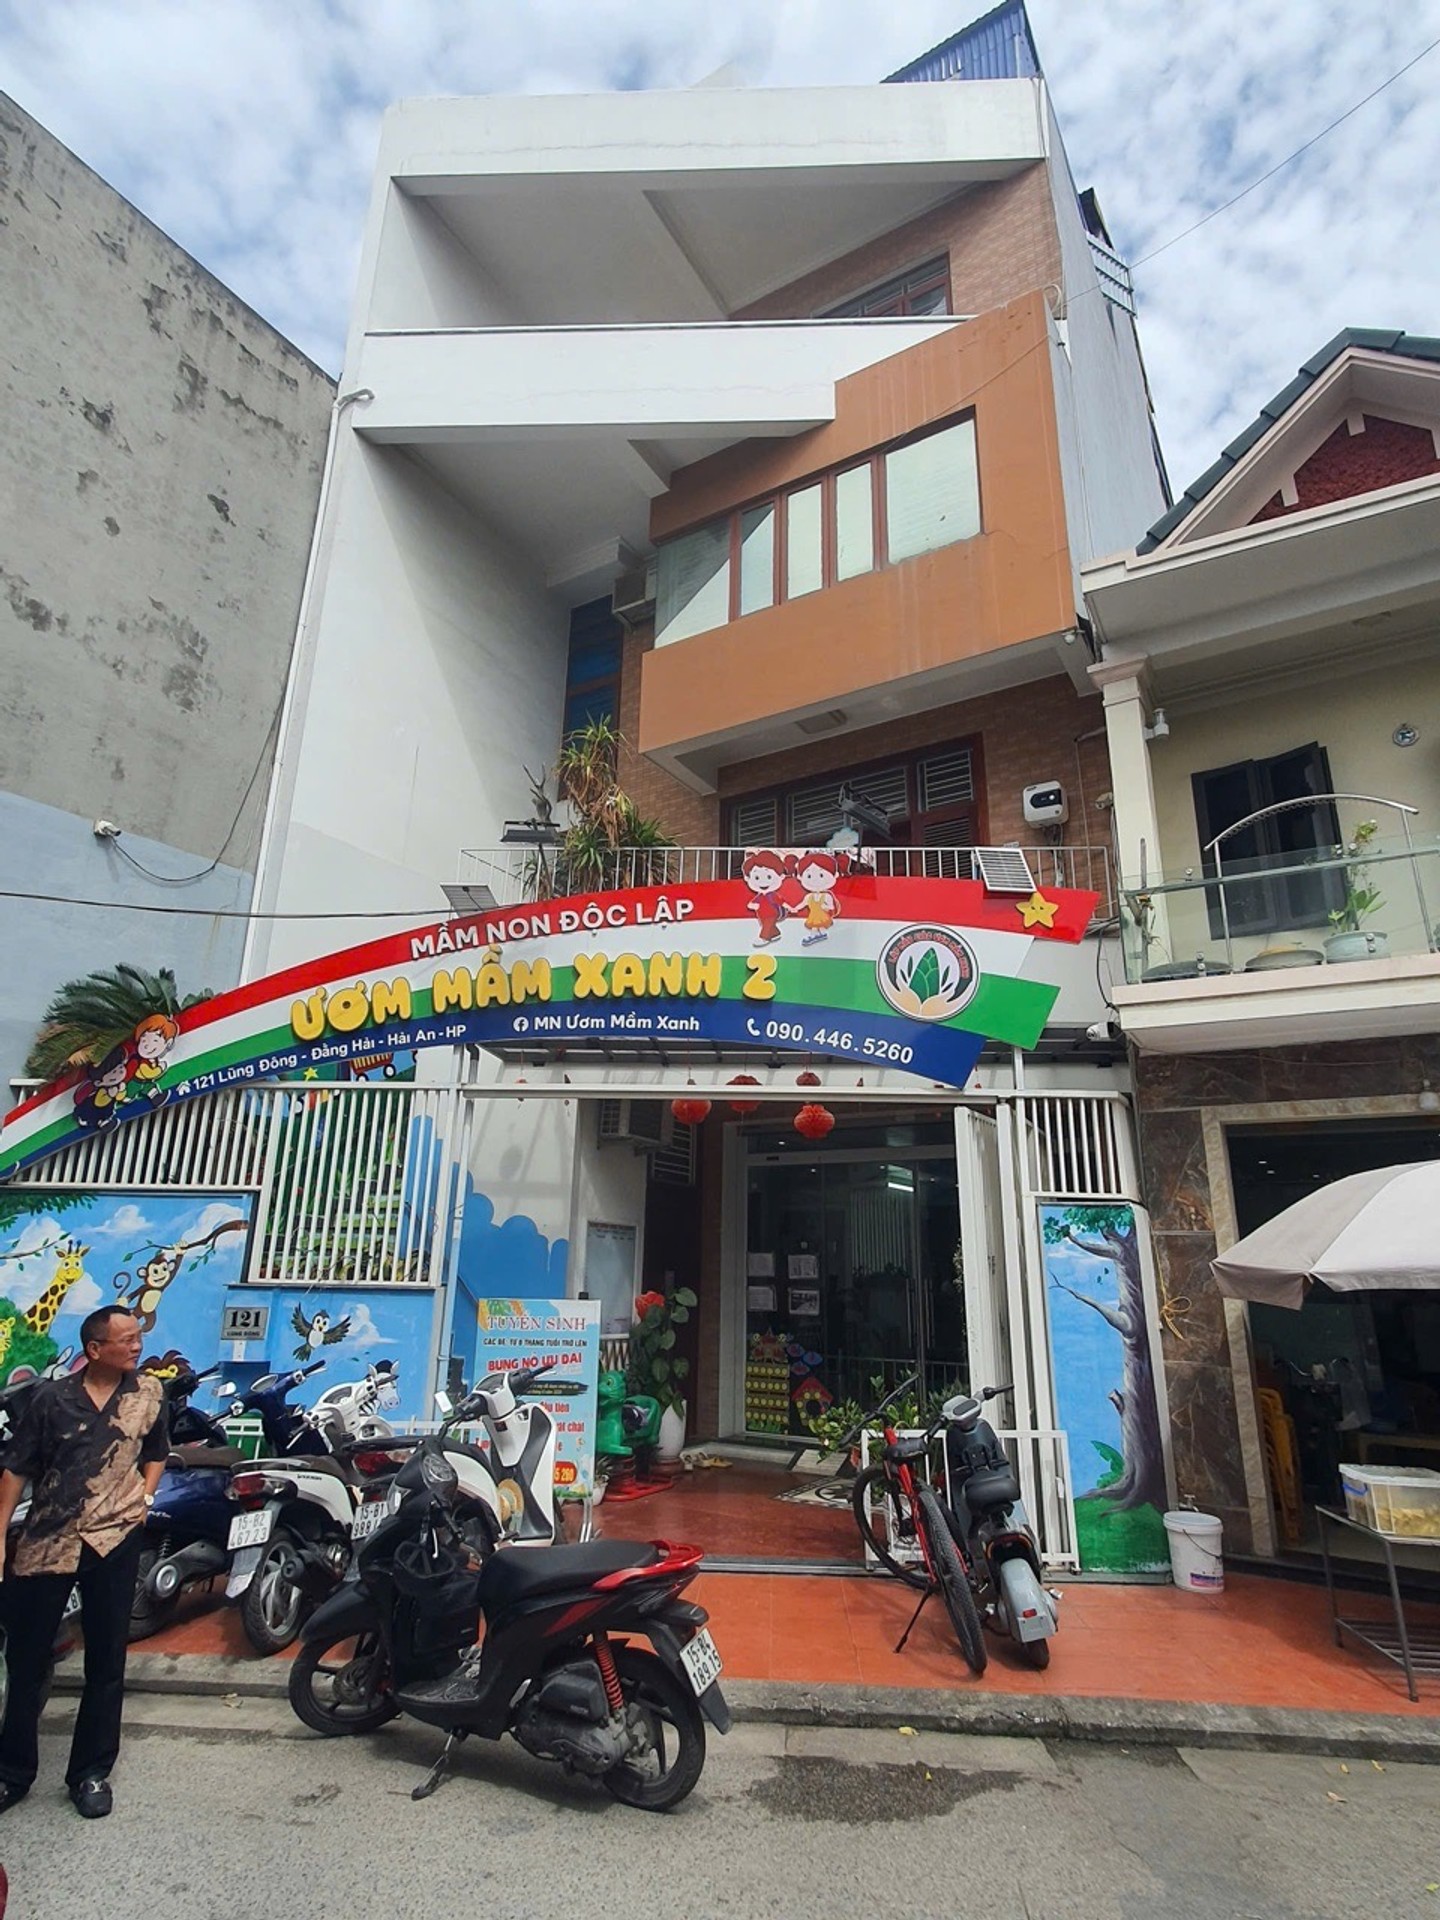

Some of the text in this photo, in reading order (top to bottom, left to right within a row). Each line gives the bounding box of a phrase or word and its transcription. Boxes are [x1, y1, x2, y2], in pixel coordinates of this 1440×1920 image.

[411, 895, 695, 959] MẦM NON ĐỘC LẬP
[290, 943, 778, 1041] ƯƠM MẦM XANH 2
[534, 1011, 700, 1031] MN Ươm Mầm Xanh
[193, 1073, 215, 1091] 121
[218, 1063, 255, 1083] Lũng
[258, 1054, 297, 1072] Đông
[352, 1037, 375, 1052] Hải
[387, 1032, 411, 1046] Hải
[230, 1310, 261, 1328] 121
[546, 1316, 586, 1331] SINH
